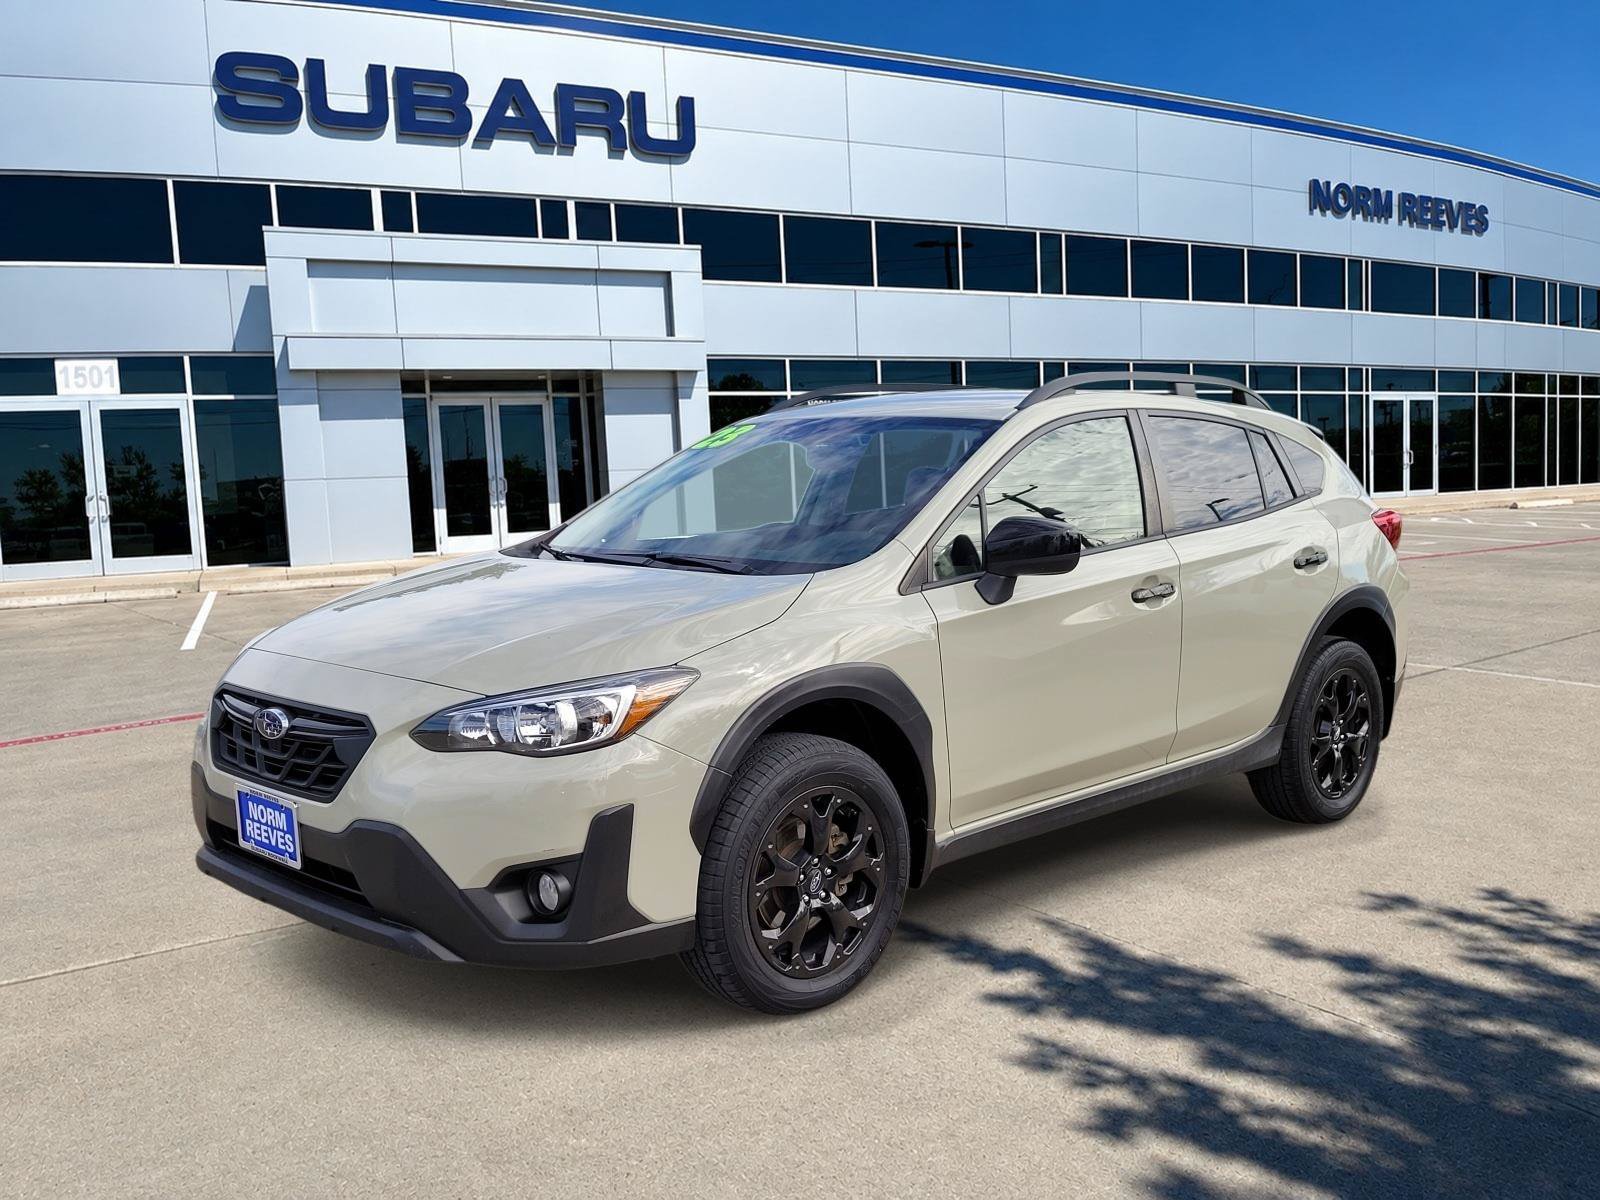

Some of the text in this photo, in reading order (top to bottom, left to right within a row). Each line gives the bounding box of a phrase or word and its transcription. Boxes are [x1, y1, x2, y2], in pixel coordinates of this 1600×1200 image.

[213, 51, 695, 157] SUBARU
[1309, 179, 1489, 235] NORM REEVES
[59, 365, 115, 388] 1501
[248, 801, 287, 831] NORM
[245, 819, 294, 853] REEVES
